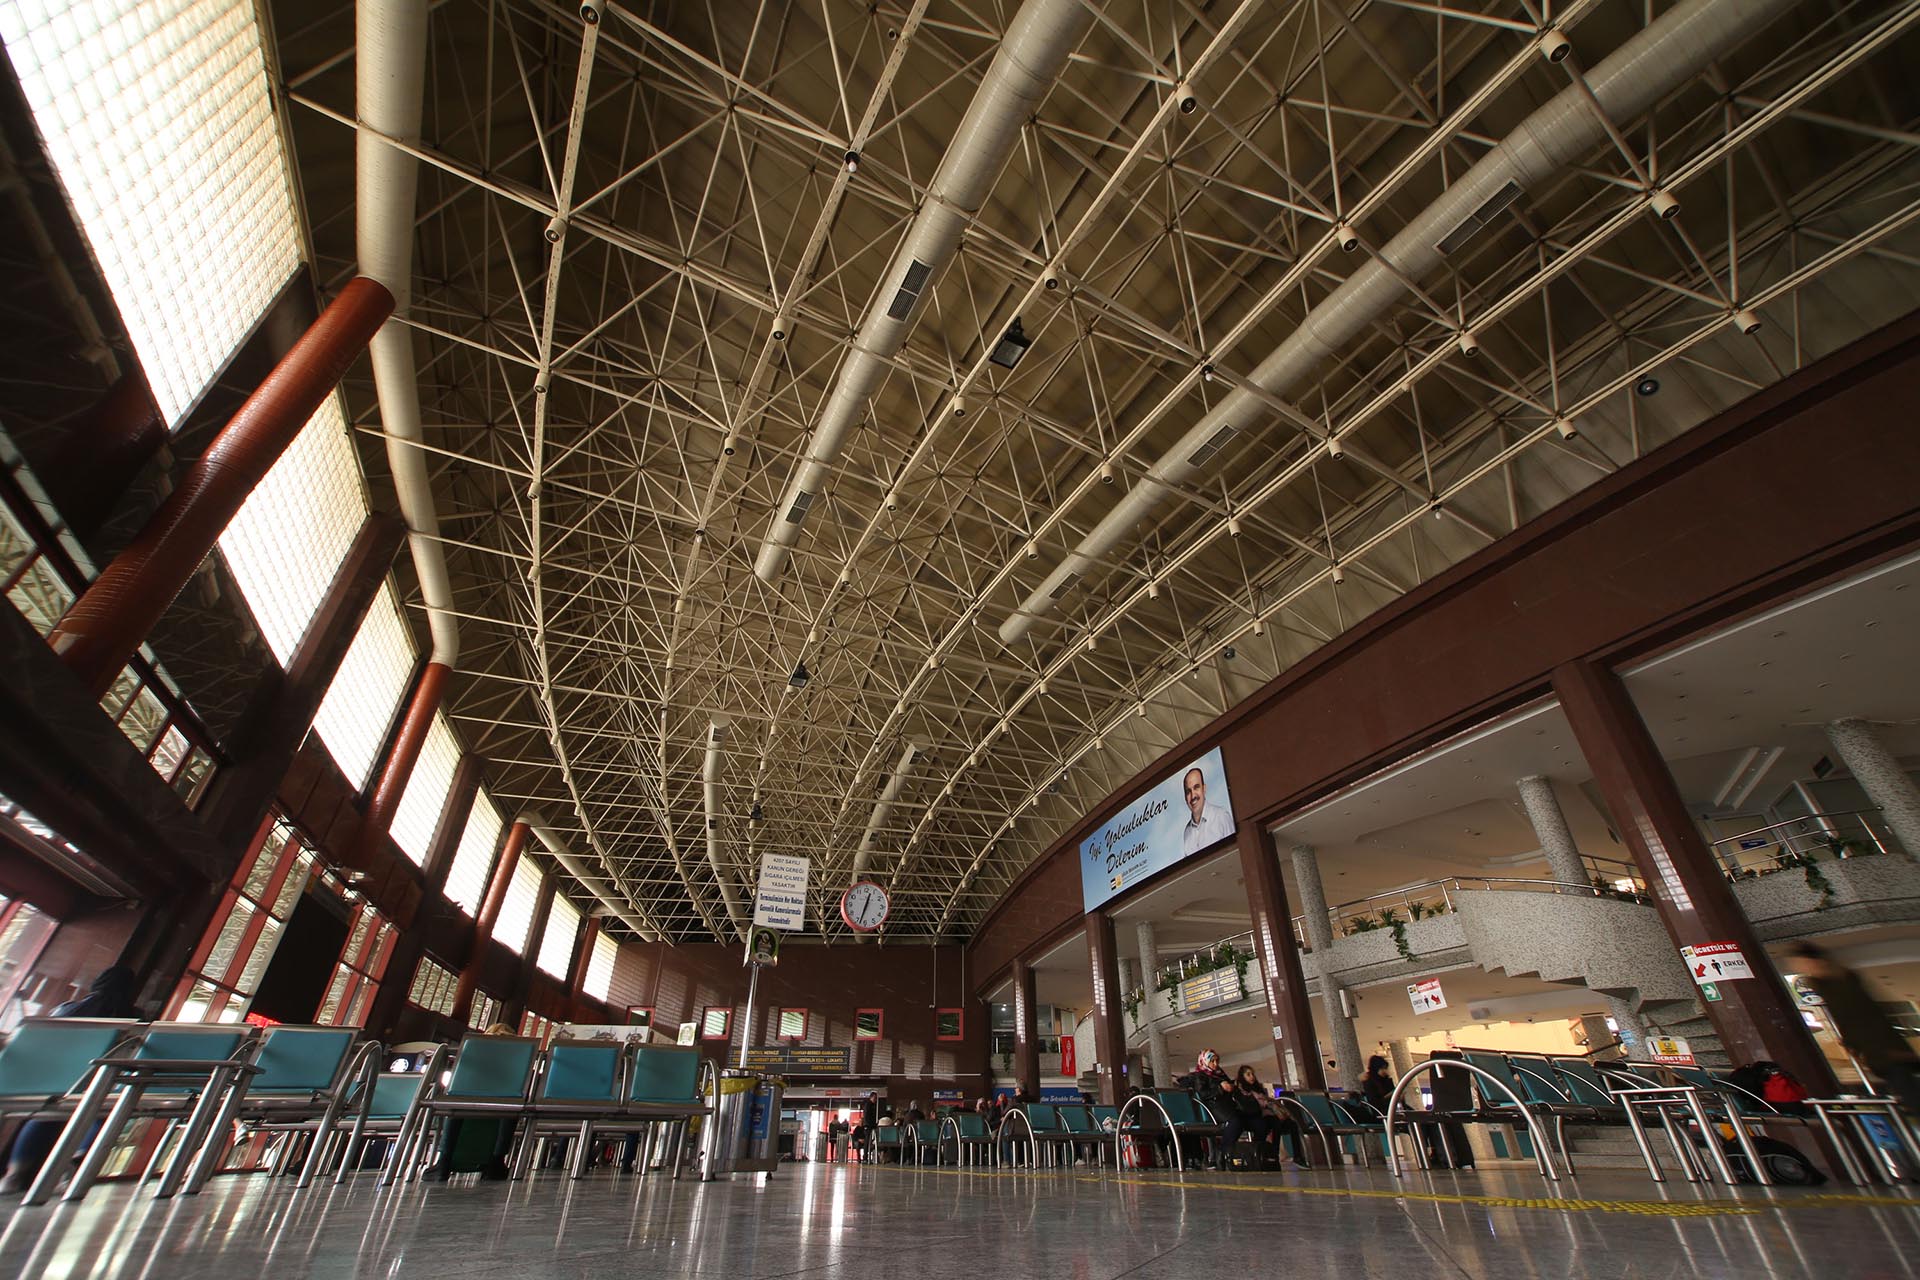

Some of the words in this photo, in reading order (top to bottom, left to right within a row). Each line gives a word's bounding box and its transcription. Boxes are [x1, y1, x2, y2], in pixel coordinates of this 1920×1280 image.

[1089, 837, 1102, 862] İyi
[1104, 799, 1169, 852] Yolculuklar
[1106, 842, 1149, 874] Dilerim.
[1693, 943, 1726, 954] ÜCRETSİZ
[1722, 959, 1746, 968] ERKEK
